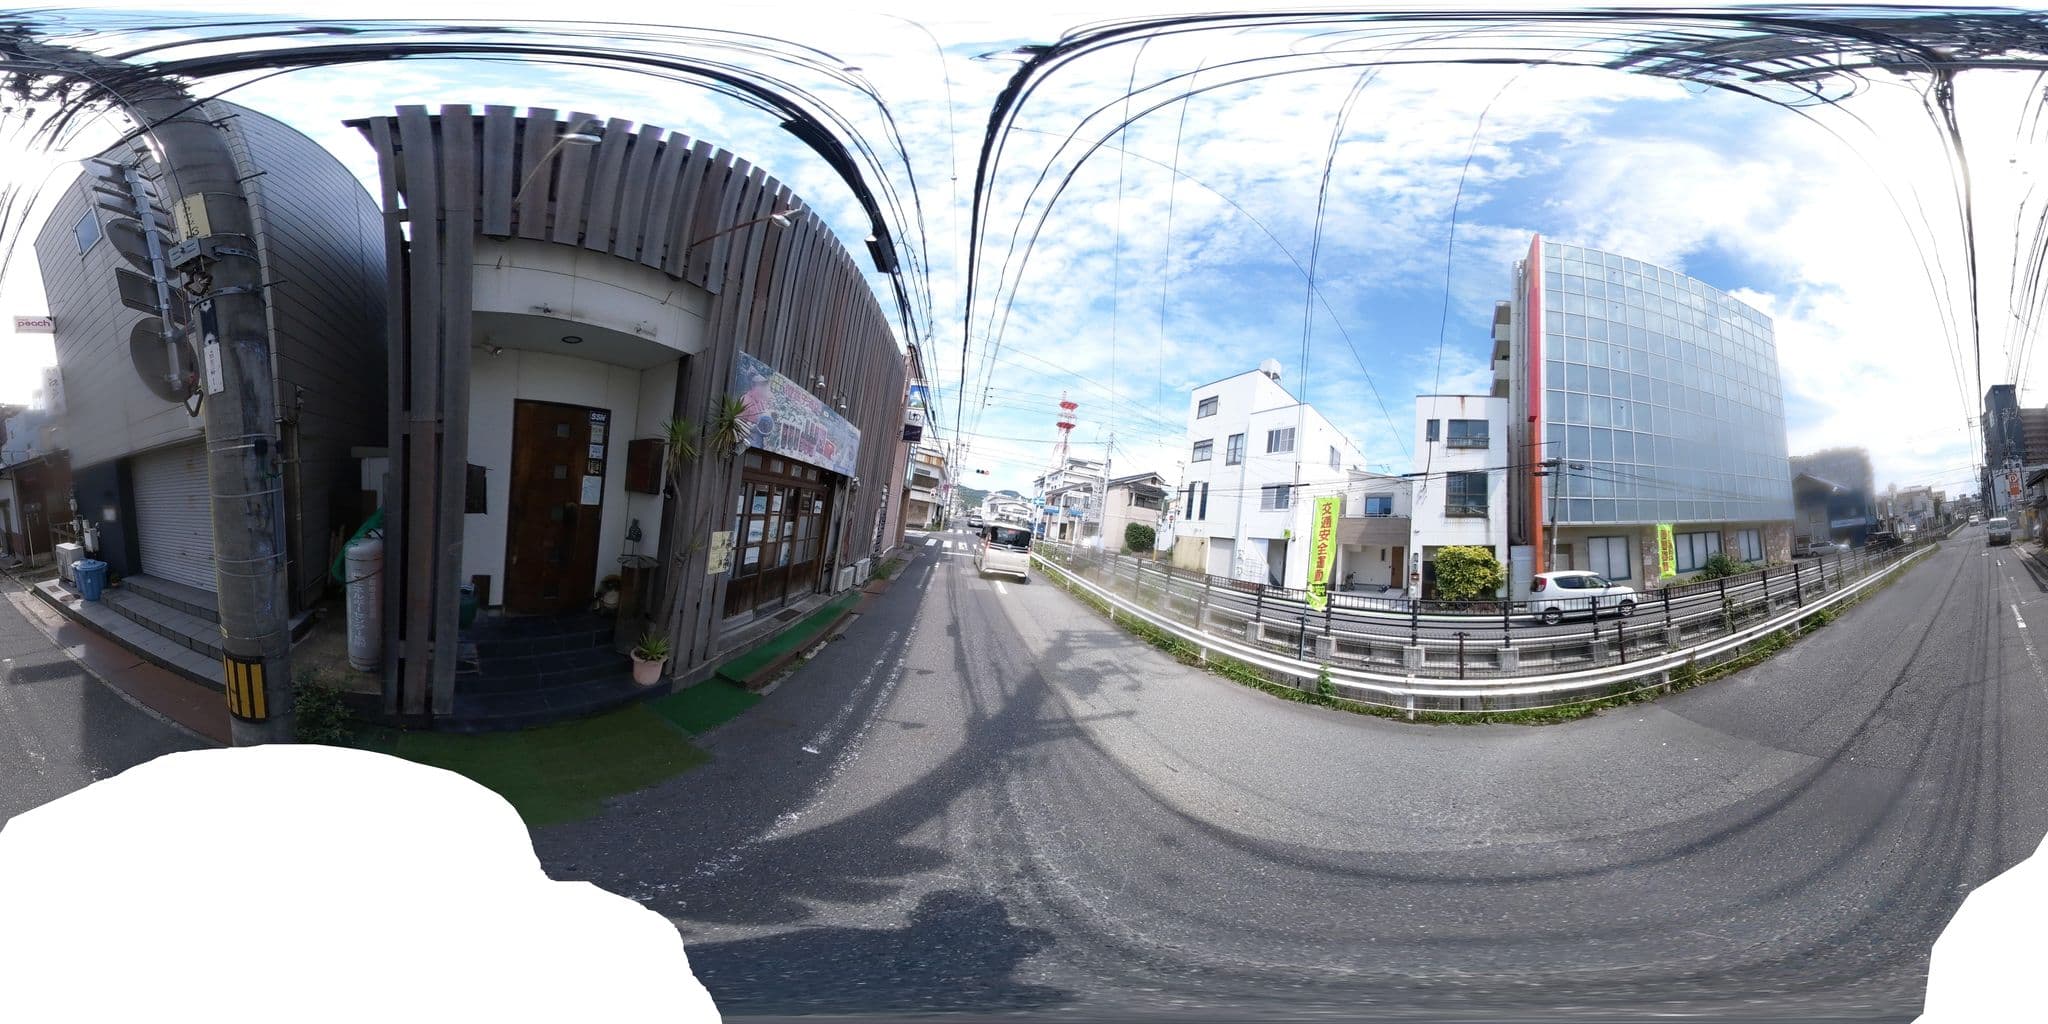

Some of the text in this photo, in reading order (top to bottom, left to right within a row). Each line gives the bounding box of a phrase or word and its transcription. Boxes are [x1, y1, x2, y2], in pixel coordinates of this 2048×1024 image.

[17, 319, 51, 328] peach
[1314, 502, 1332, 582] 交通安全運動
